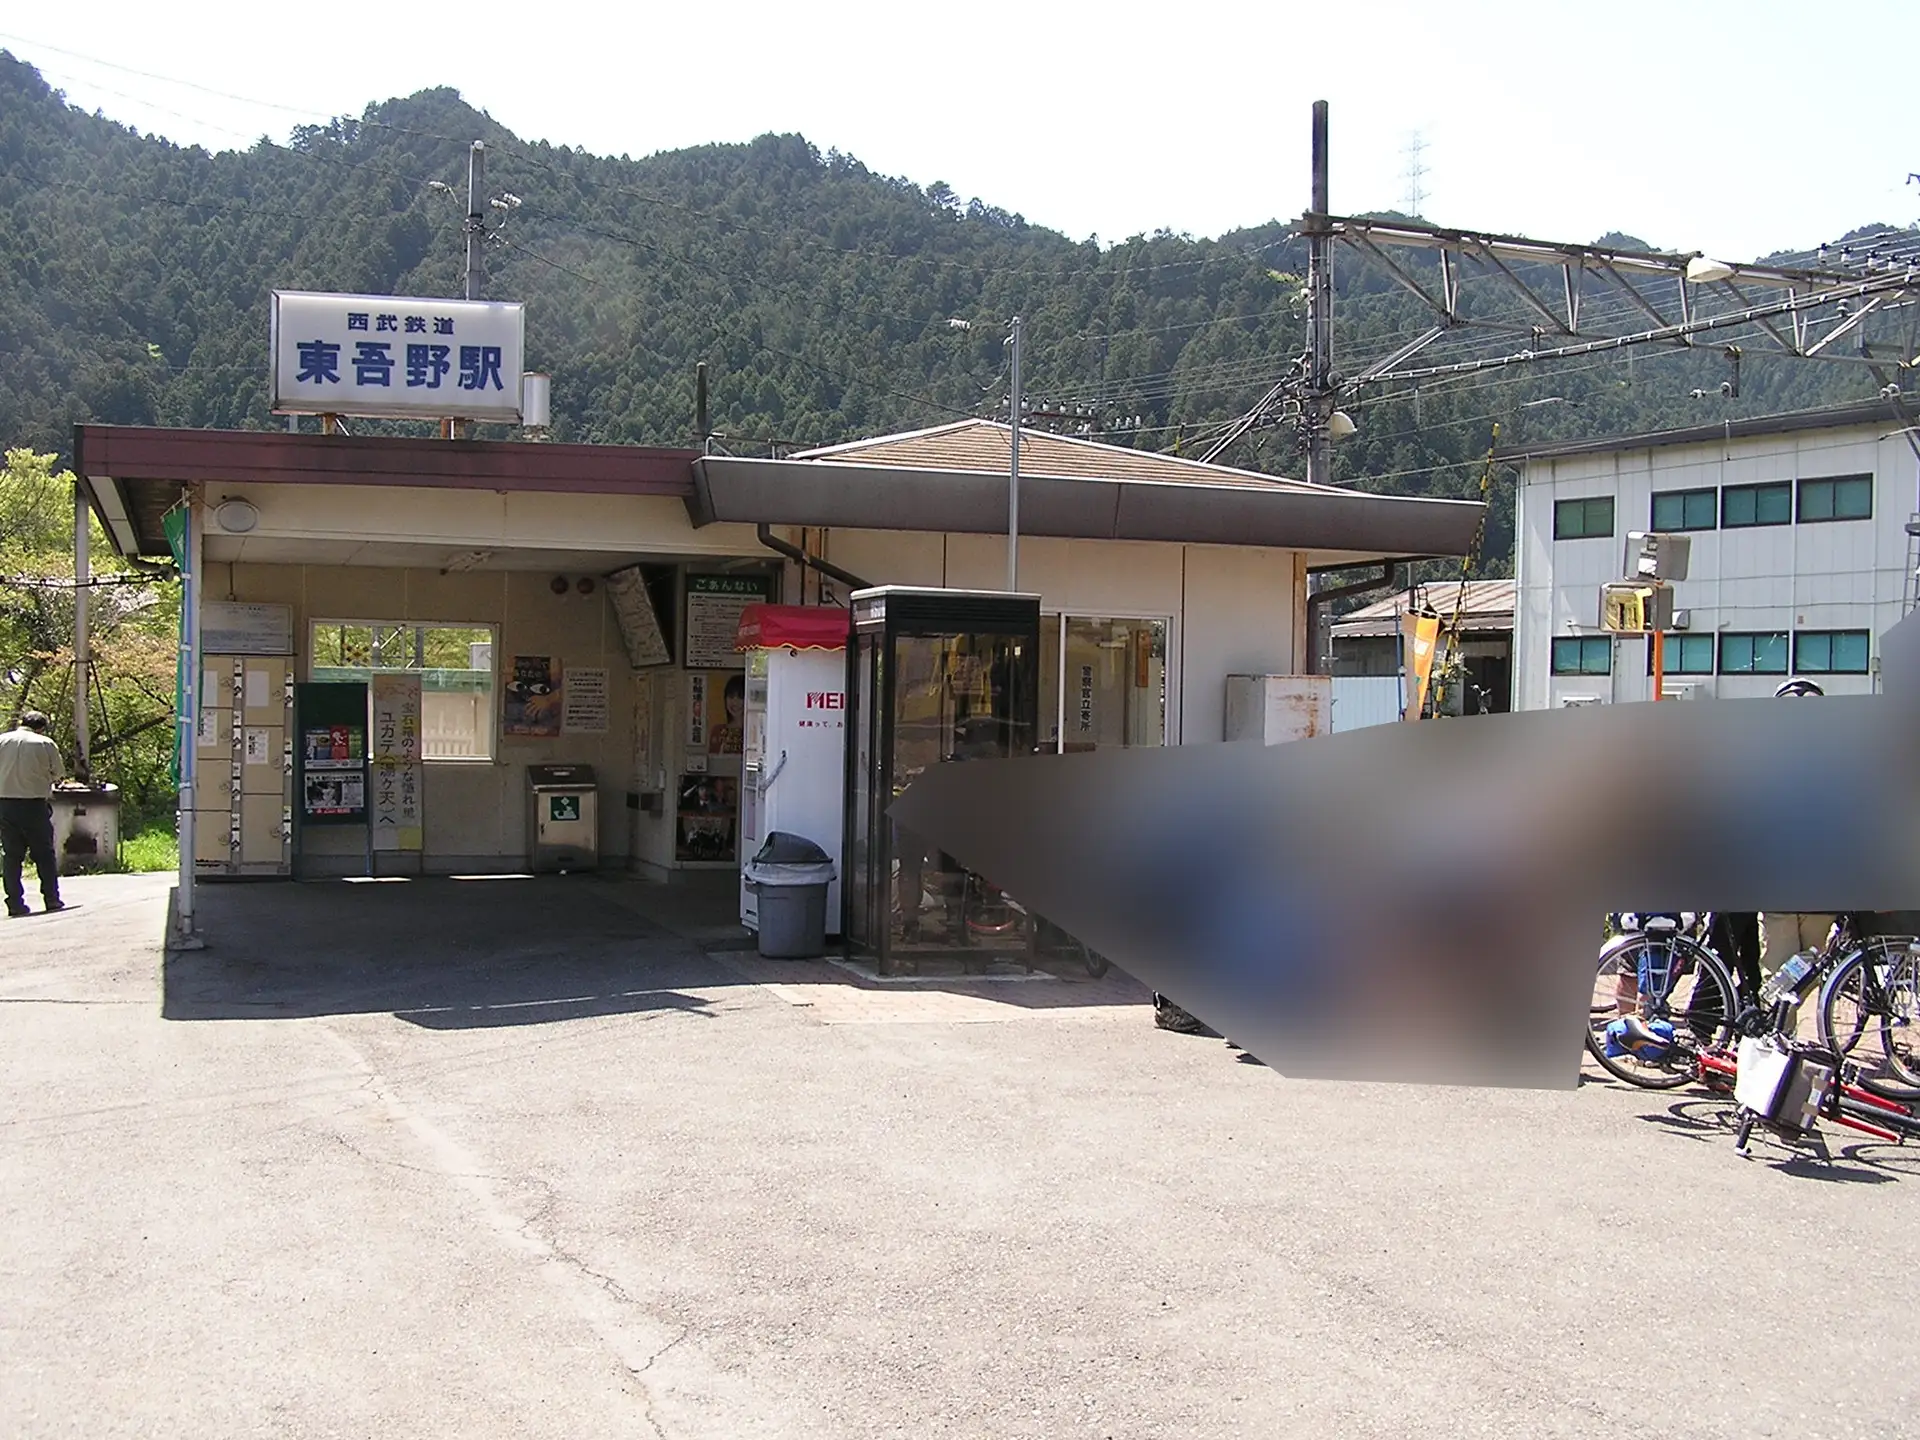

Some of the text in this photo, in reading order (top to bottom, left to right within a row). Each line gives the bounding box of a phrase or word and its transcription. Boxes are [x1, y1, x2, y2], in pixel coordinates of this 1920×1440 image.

[347, 312, 456, 335] 西武鉄道
[296, 339, 504, 391] 東吾野駅
[695, 579, 758, 591] ごあんない
[1080, 666, 1092, 732] 警察官立寄所
